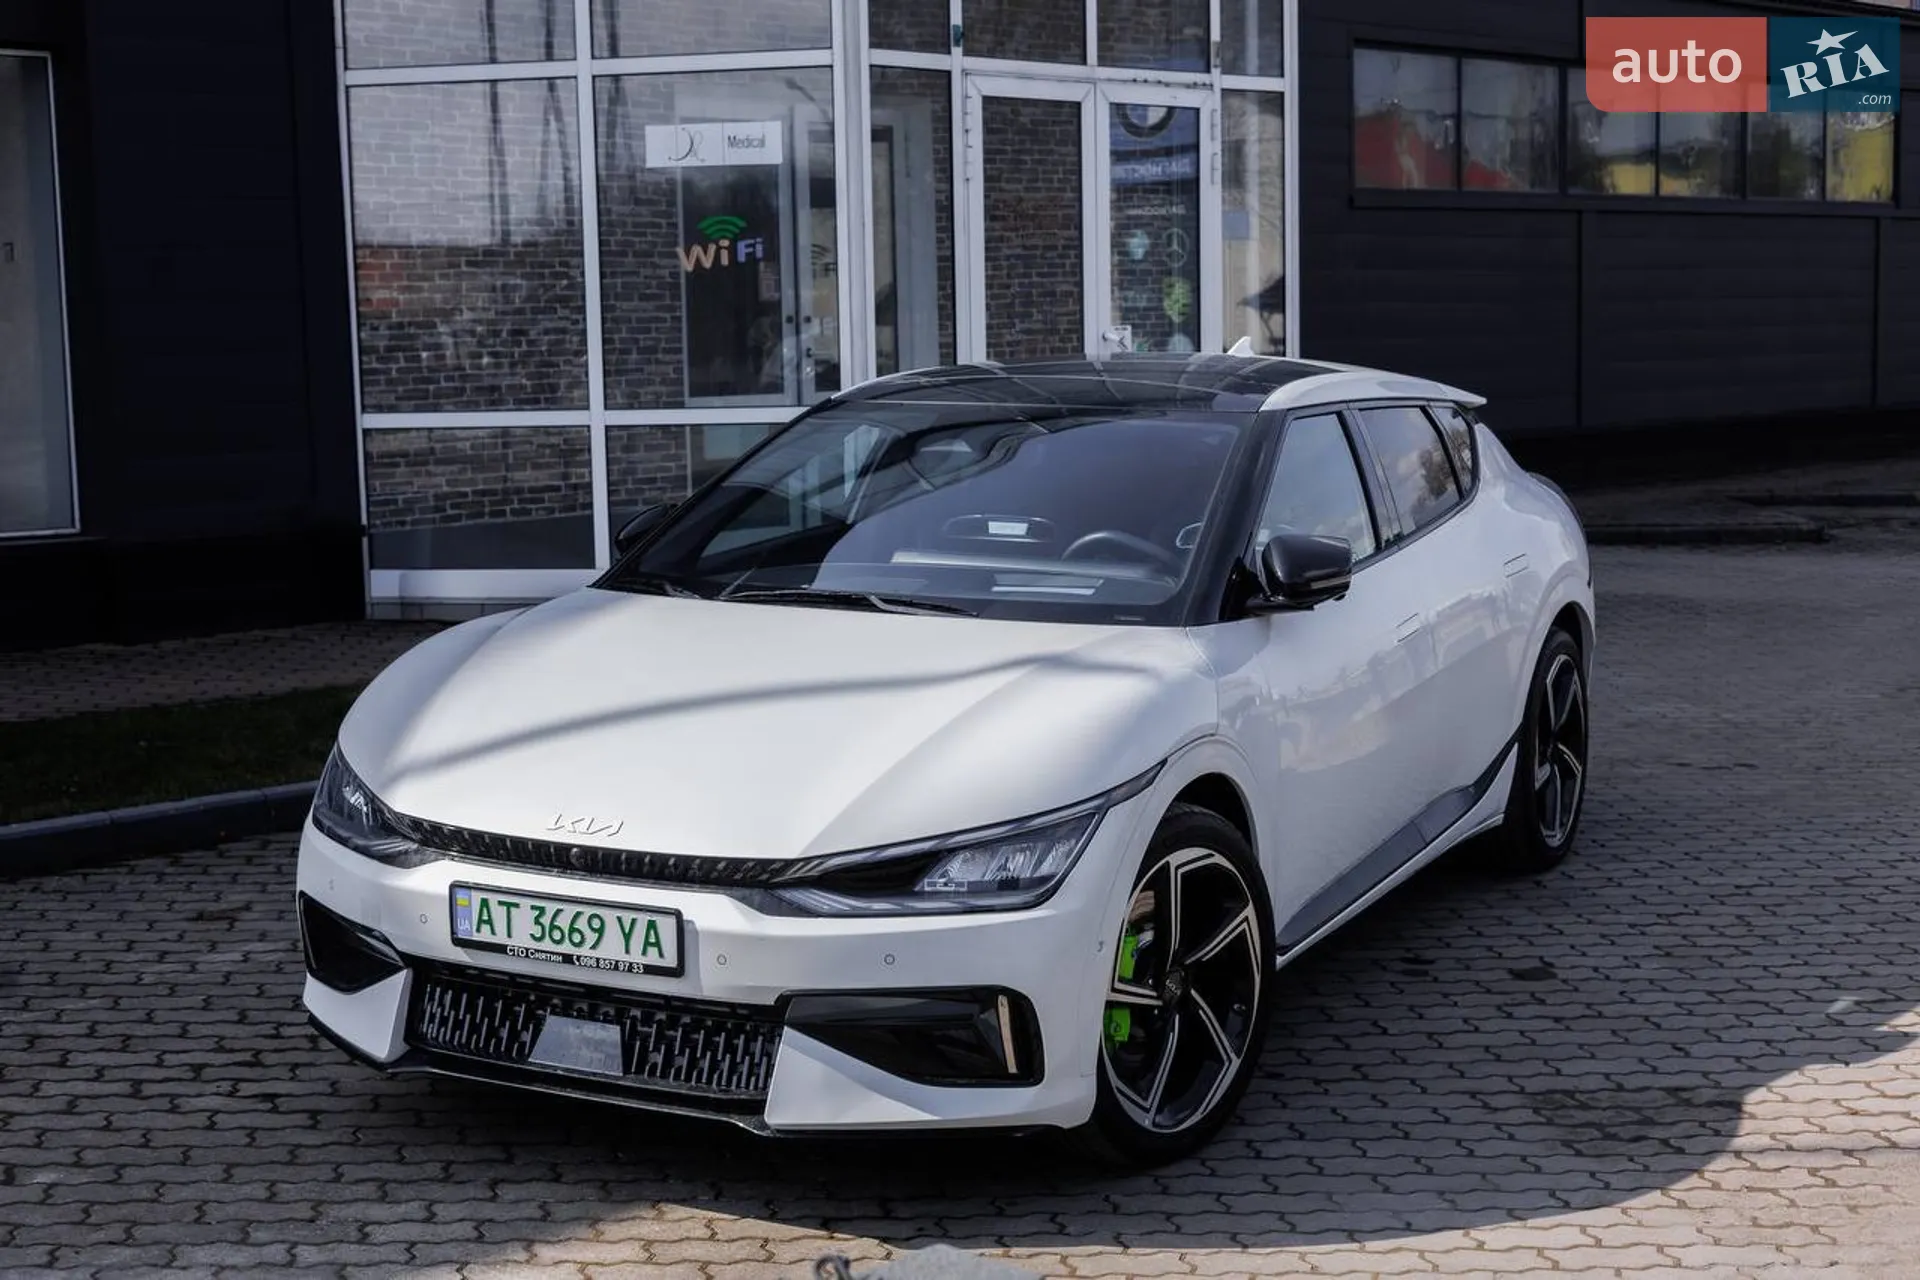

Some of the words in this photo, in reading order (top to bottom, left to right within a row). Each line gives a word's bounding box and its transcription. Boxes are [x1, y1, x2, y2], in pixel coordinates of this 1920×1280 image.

[727, 134, 766, 149] Medical
[457, 919, 471, 931] UA
[475, 897, 520, 938] AT
[529, 904, 606, 950] 3669
[616, 915, 665, 959] YA
